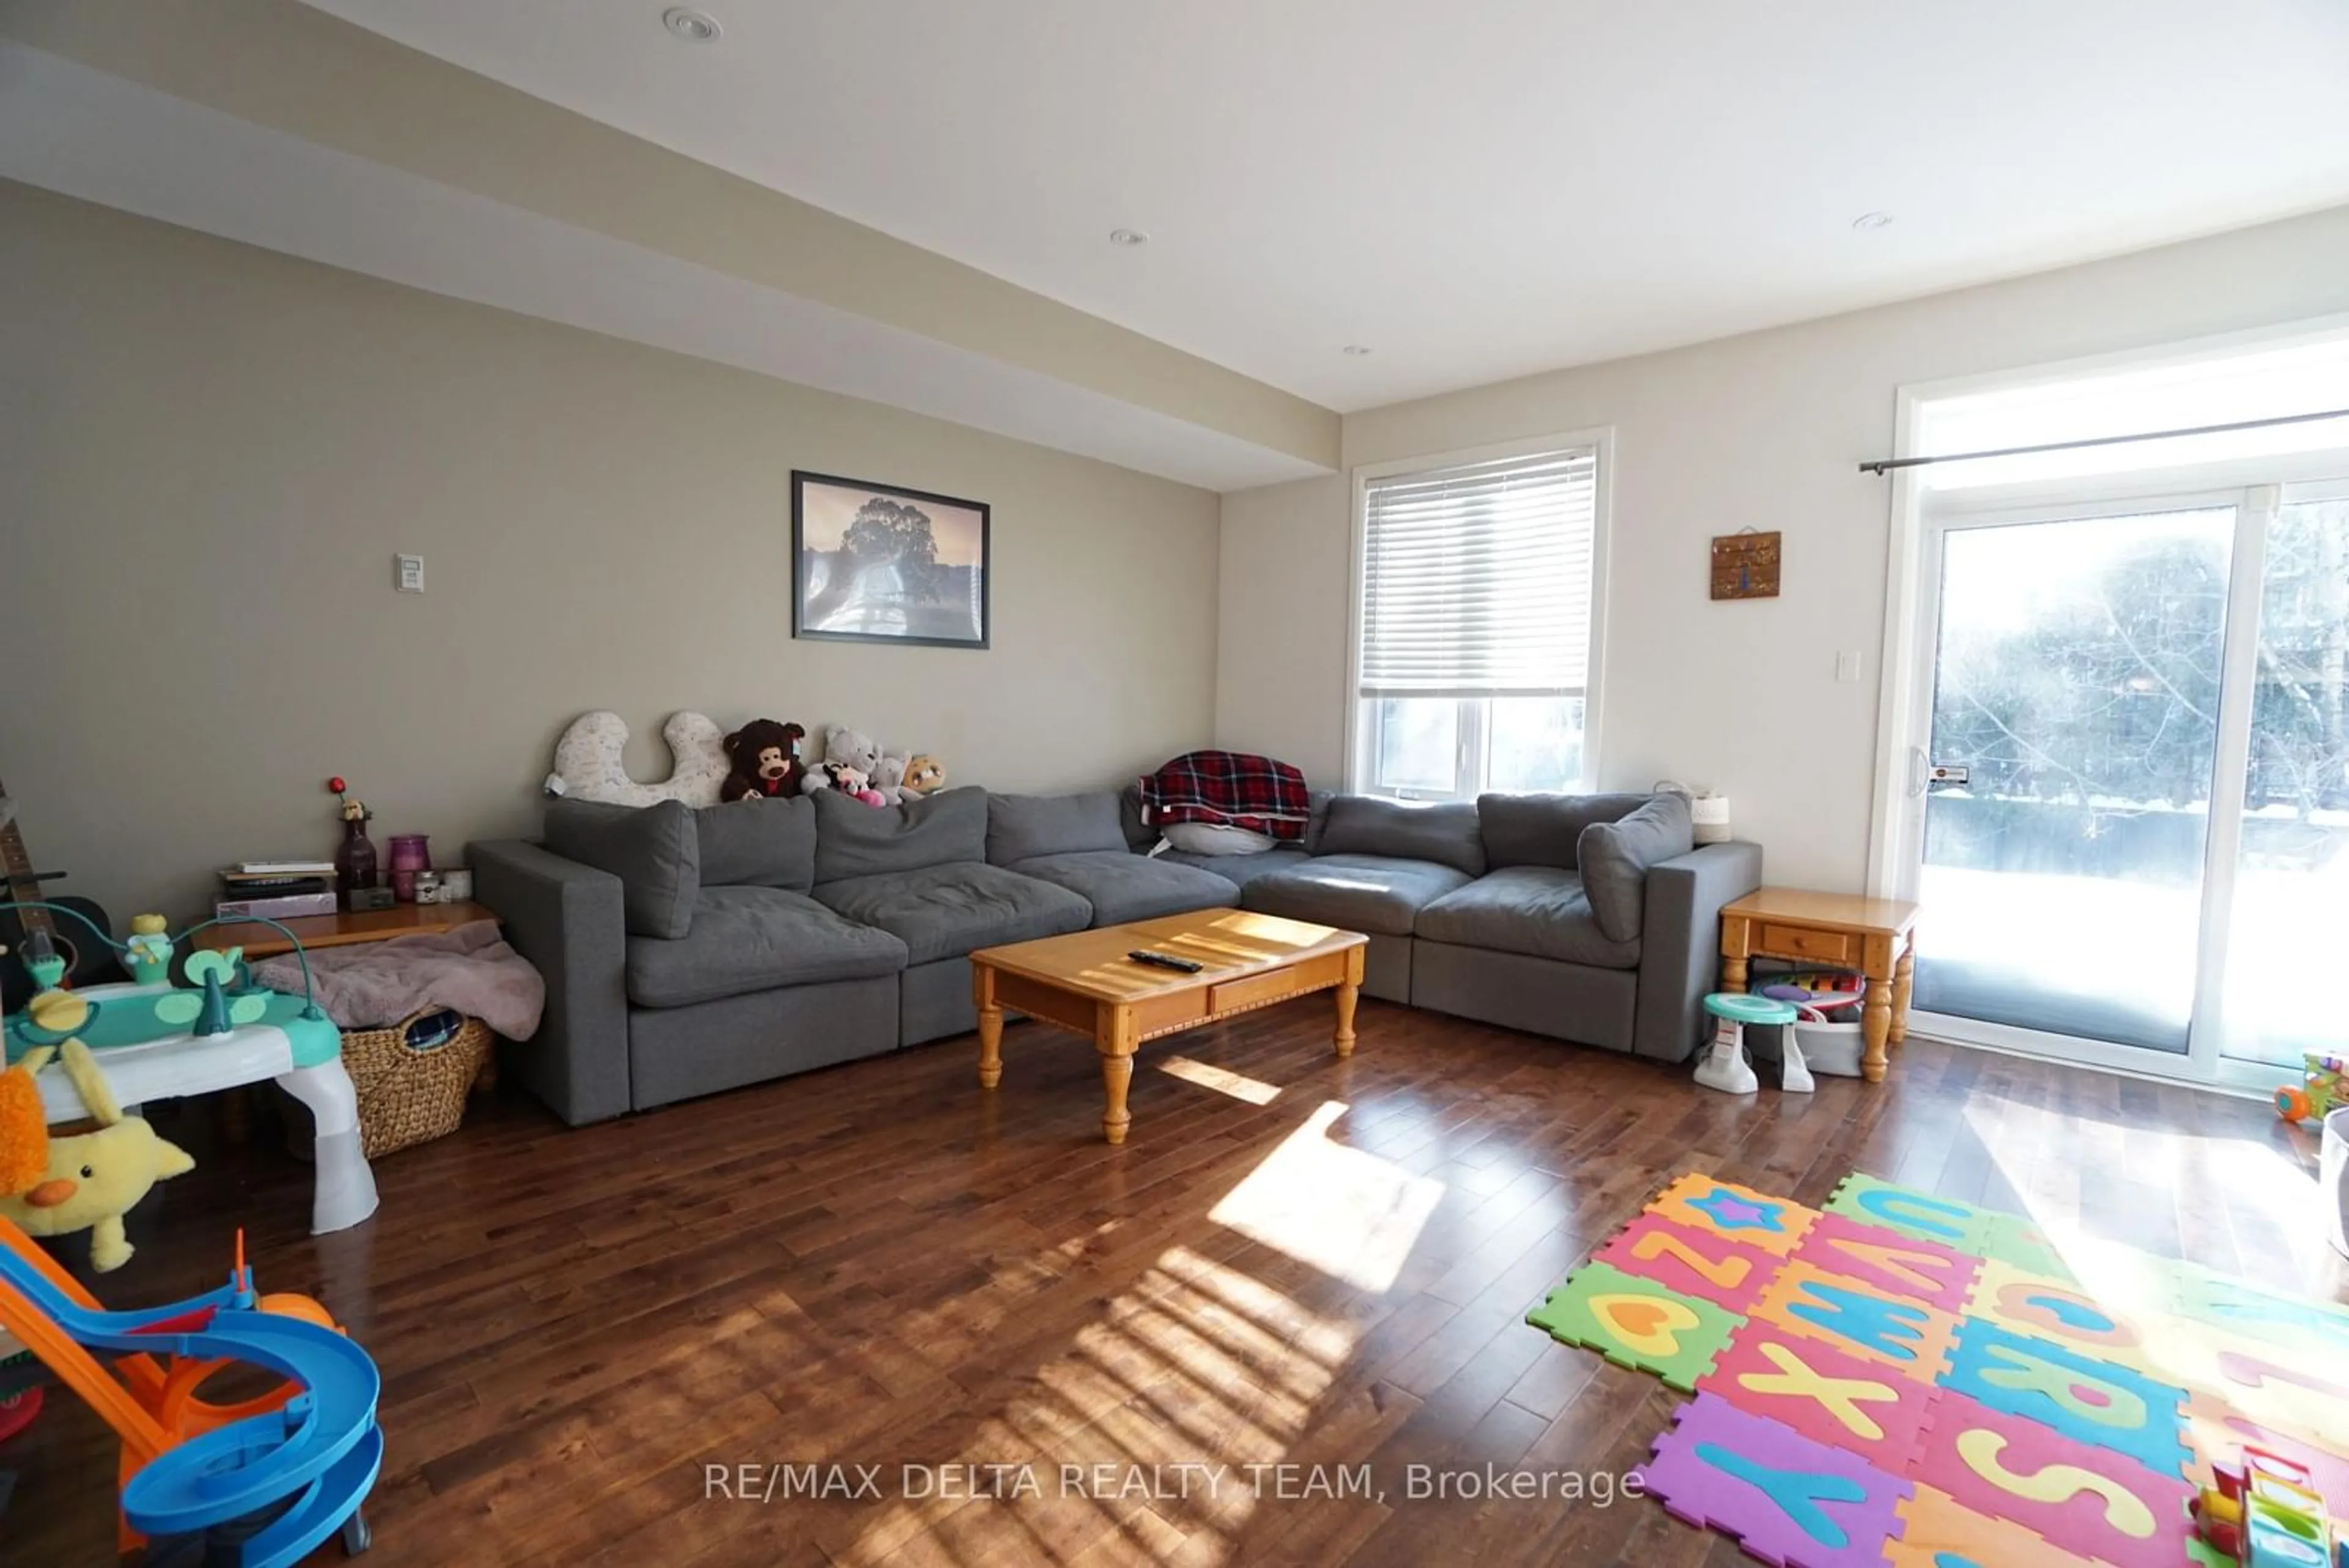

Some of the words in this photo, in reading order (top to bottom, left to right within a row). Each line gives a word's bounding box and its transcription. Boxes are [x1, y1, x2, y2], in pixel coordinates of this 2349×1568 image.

[1857, 1190, 1972, 1239] U
[1630, 1231, 1753, 1289] Z
[1825, 1238, 1954, 1292] V
[1786, 1280, 1930, 1361] W
[1992, 1283, 2144, 1348] Q
[1737, 1342, 1900, 1440] X
[1978, 1343, 2148, 1429] R
[1693, 1442, 1867, 1549] Y
[1956, 1427, 2157, 1539] S
